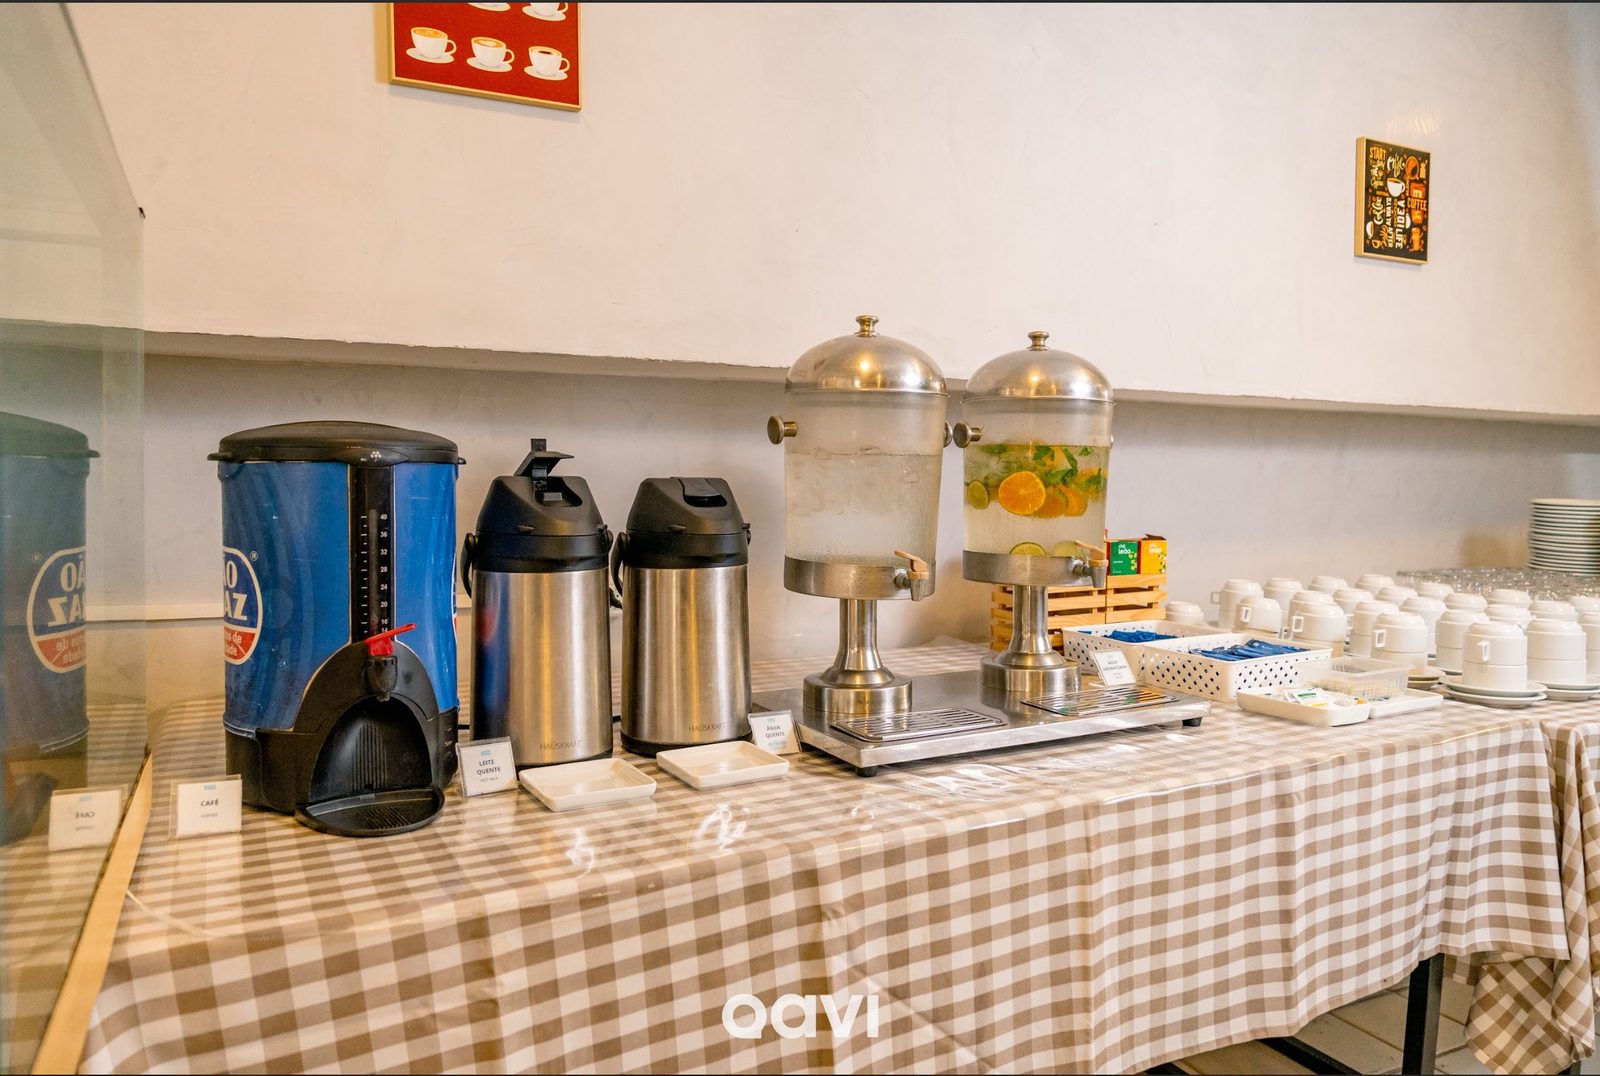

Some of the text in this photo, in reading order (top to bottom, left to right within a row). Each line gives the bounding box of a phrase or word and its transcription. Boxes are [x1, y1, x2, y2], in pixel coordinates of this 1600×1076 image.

[1370, 147, 1386, 161] START
[1407, 198, 1427, 211] COFFEE
[1397, 200, 1405, 228] IDEA
[689, 722, 728, 732] HAUSKRAFT
[540, 740, 582, 750] HAUSKRAFT
[477, 767, 501, 775] QUENTE
[200, 798, 220, 806] CAFÉ
